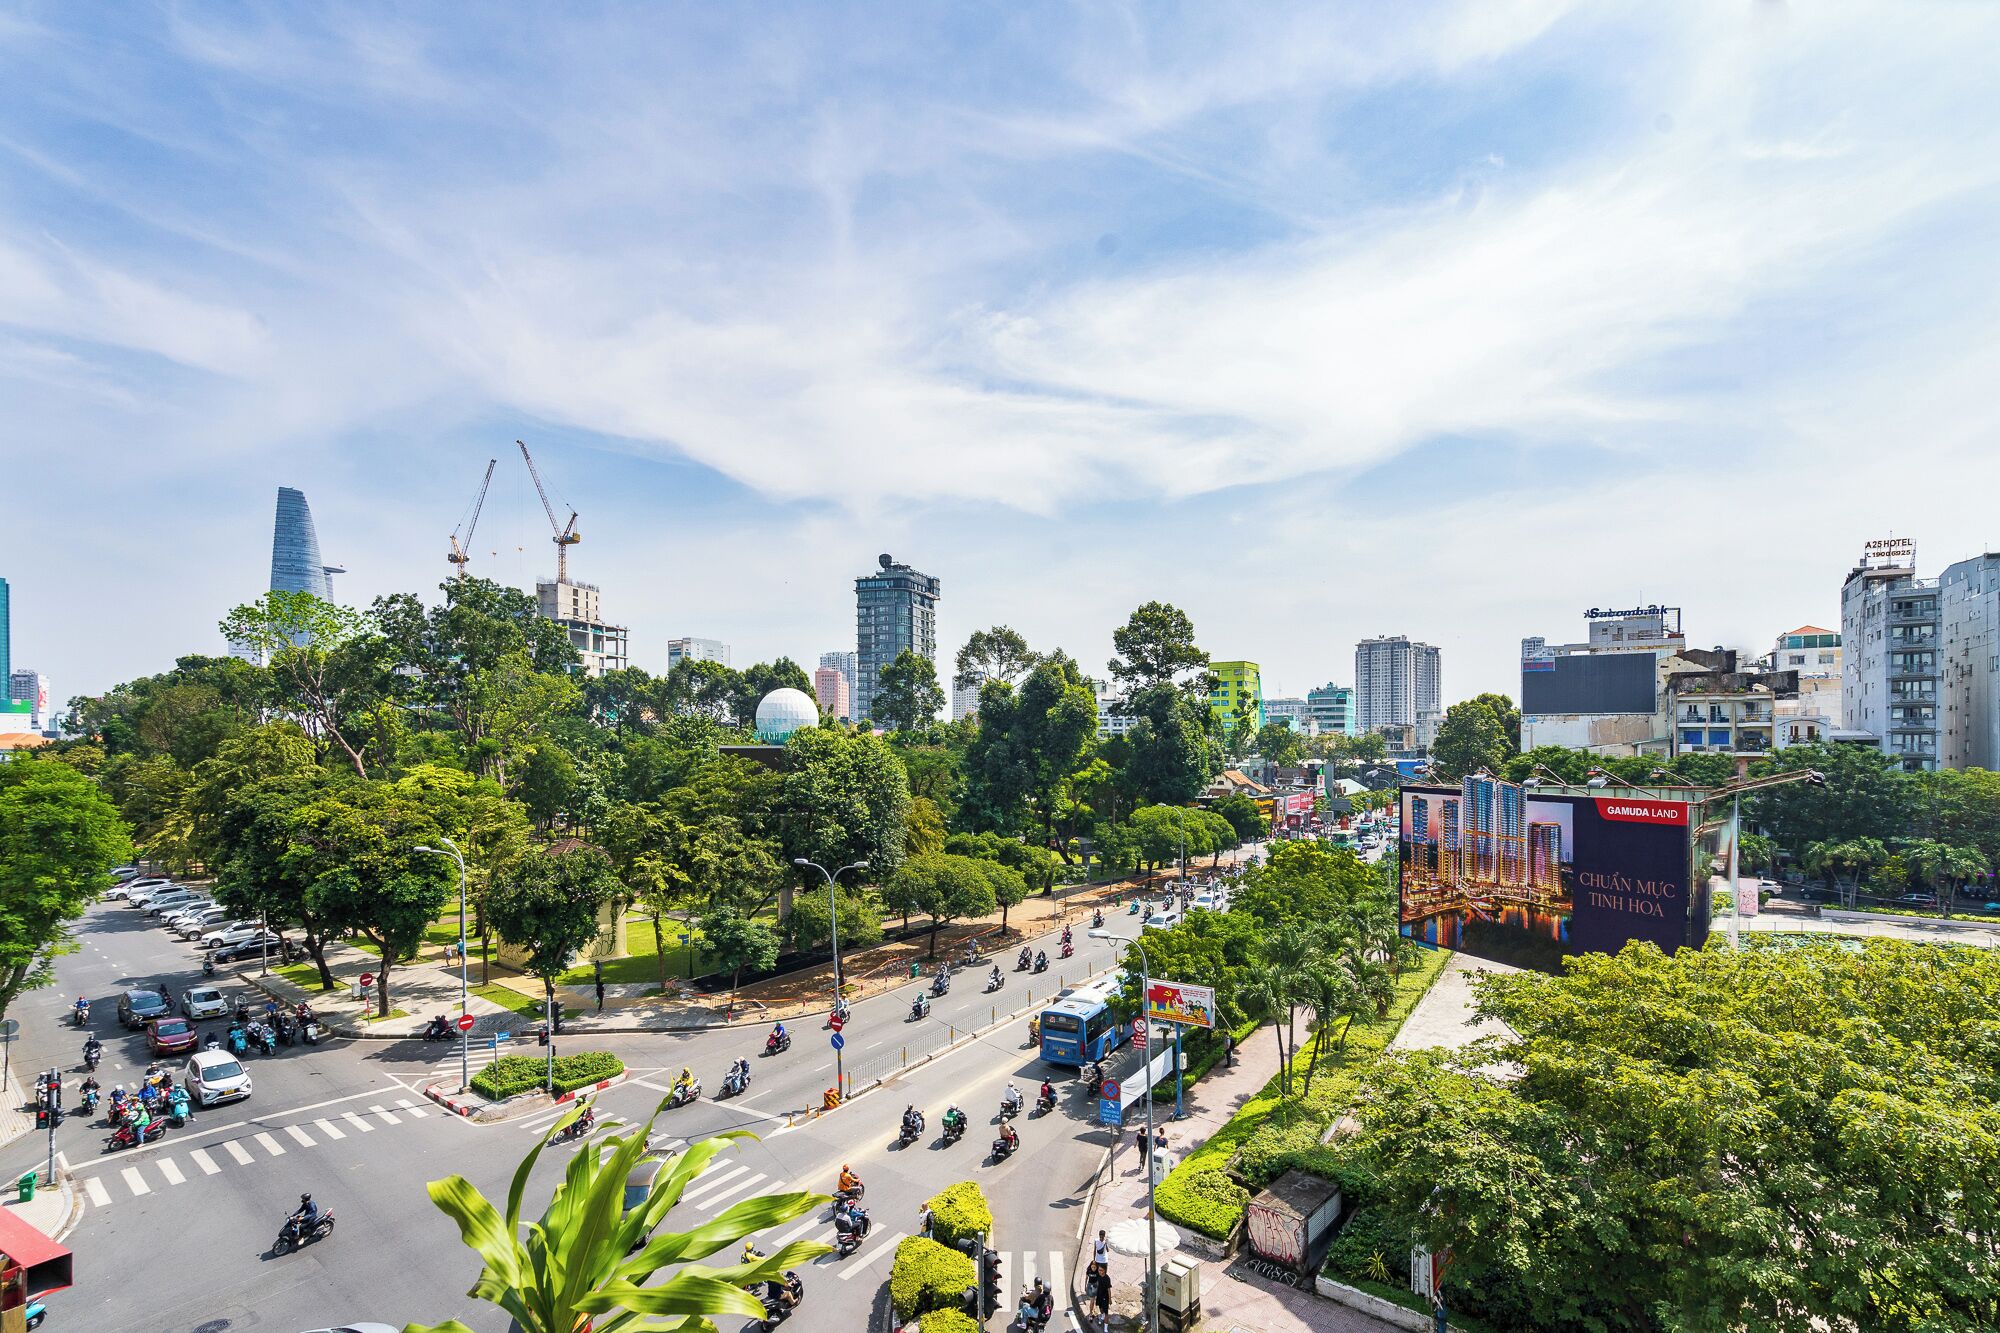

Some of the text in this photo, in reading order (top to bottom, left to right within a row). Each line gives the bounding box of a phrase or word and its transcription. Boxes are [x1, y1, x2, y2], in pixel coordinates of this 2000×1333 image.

[1883, 538, 1913, 548] HOTEL
[1607, 805, 1679, 819] GAMUDA LAND
[1579, 871, 1676, 899] CHUẨN MỰC
[1628, 897, 1665, 918] HOA
